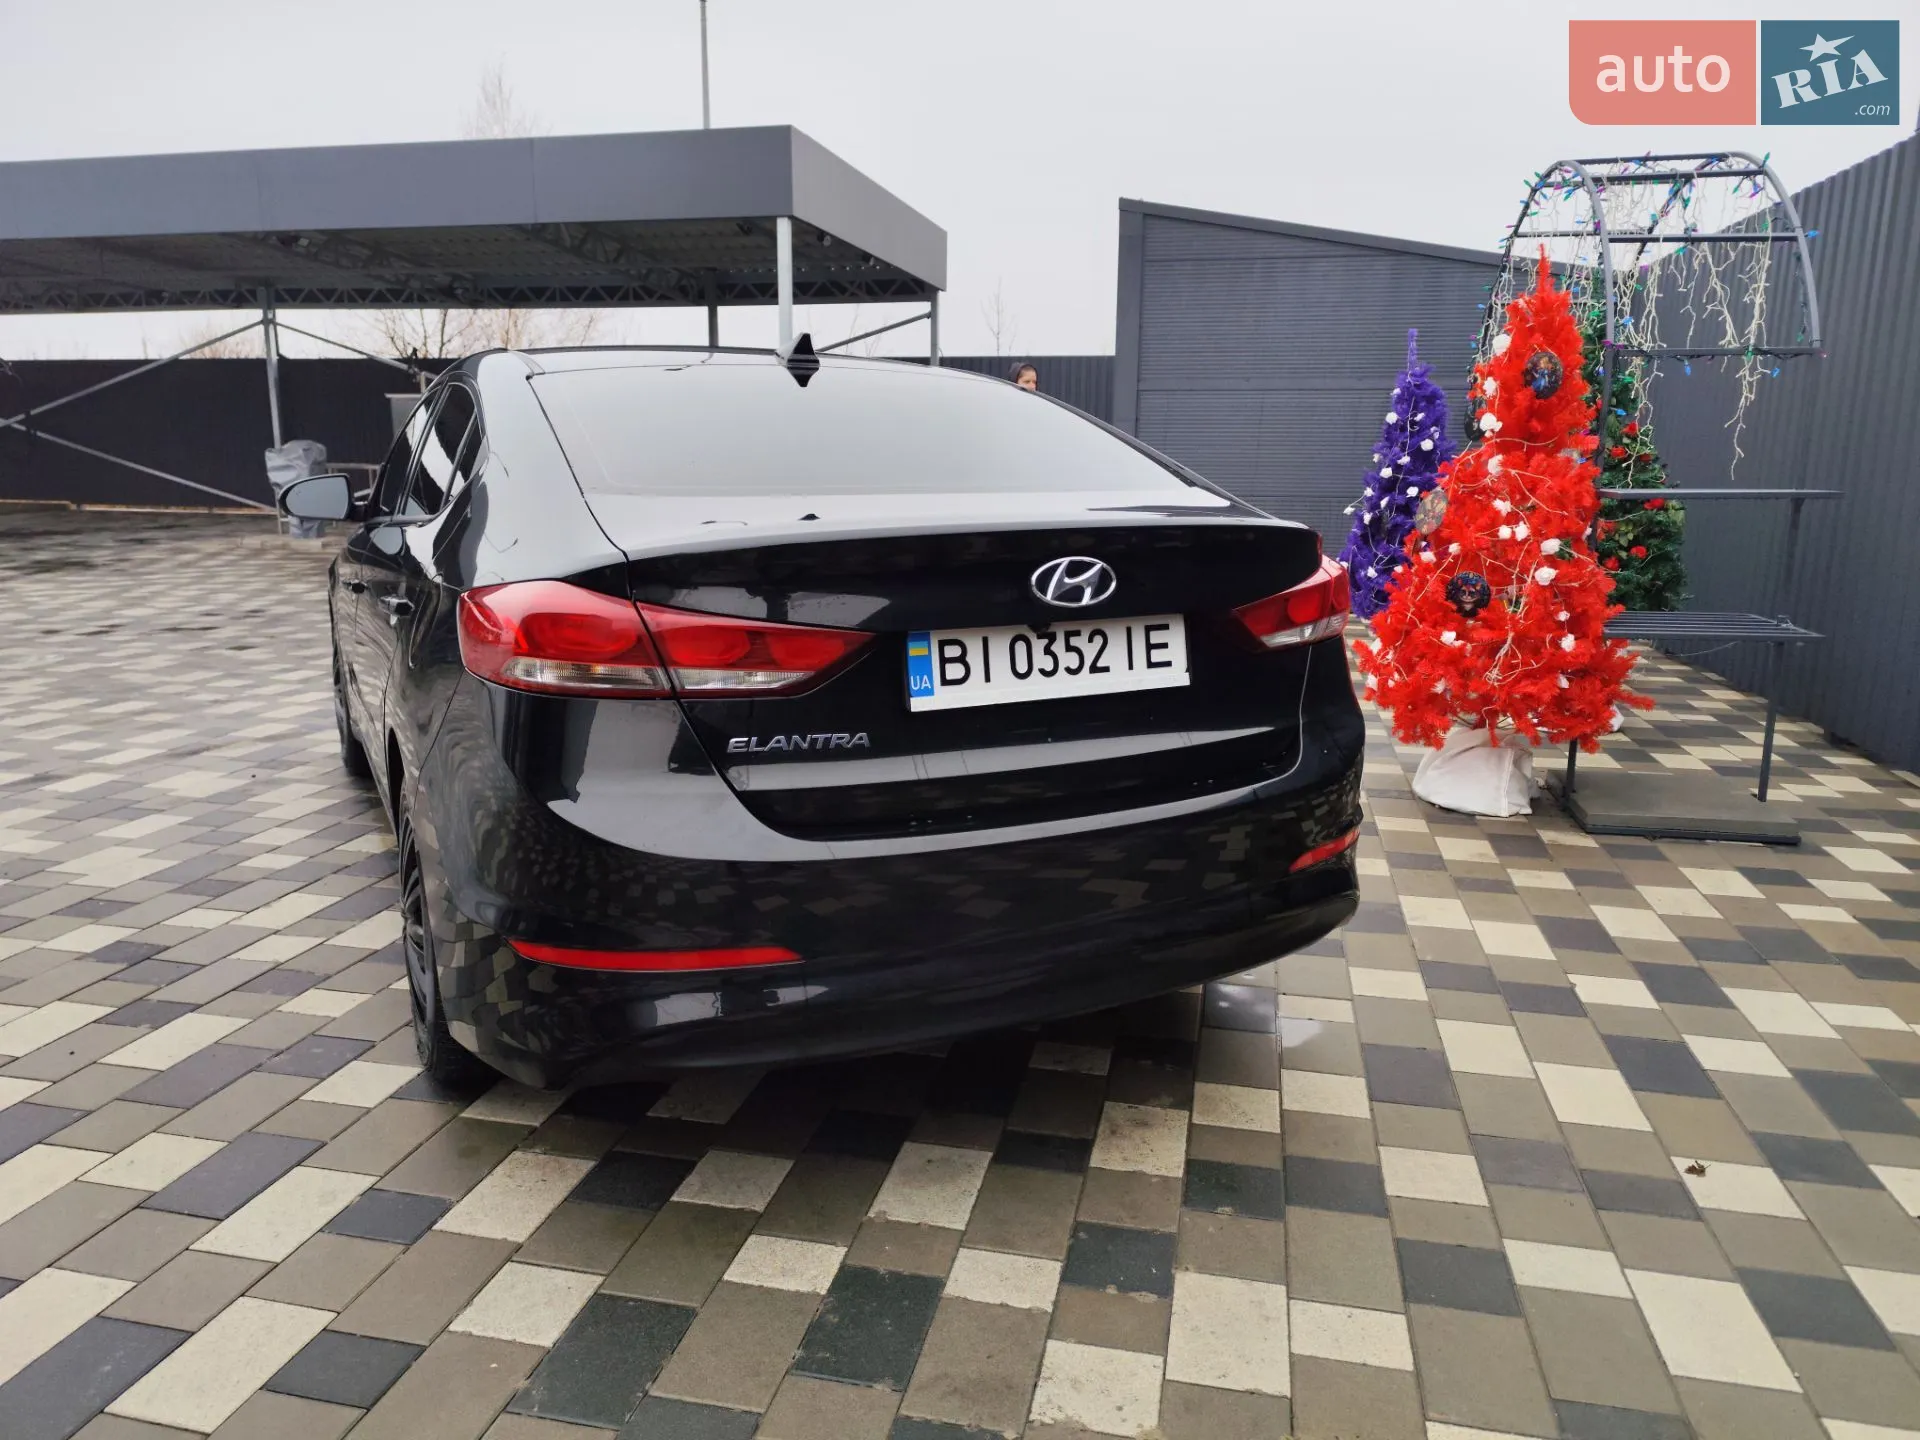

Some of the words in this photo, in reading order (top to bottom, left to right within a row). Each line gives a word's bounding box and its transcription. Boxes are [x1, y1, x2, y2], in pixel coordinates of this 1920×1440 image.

[938, 636, 991, 687] BI
[1008, 628, 1111, 680] 0352
[1126, 624, 1173, 671] IE
[911, 675, 931, 691] UA
[727, 732, 871, 753] ELANTRA
